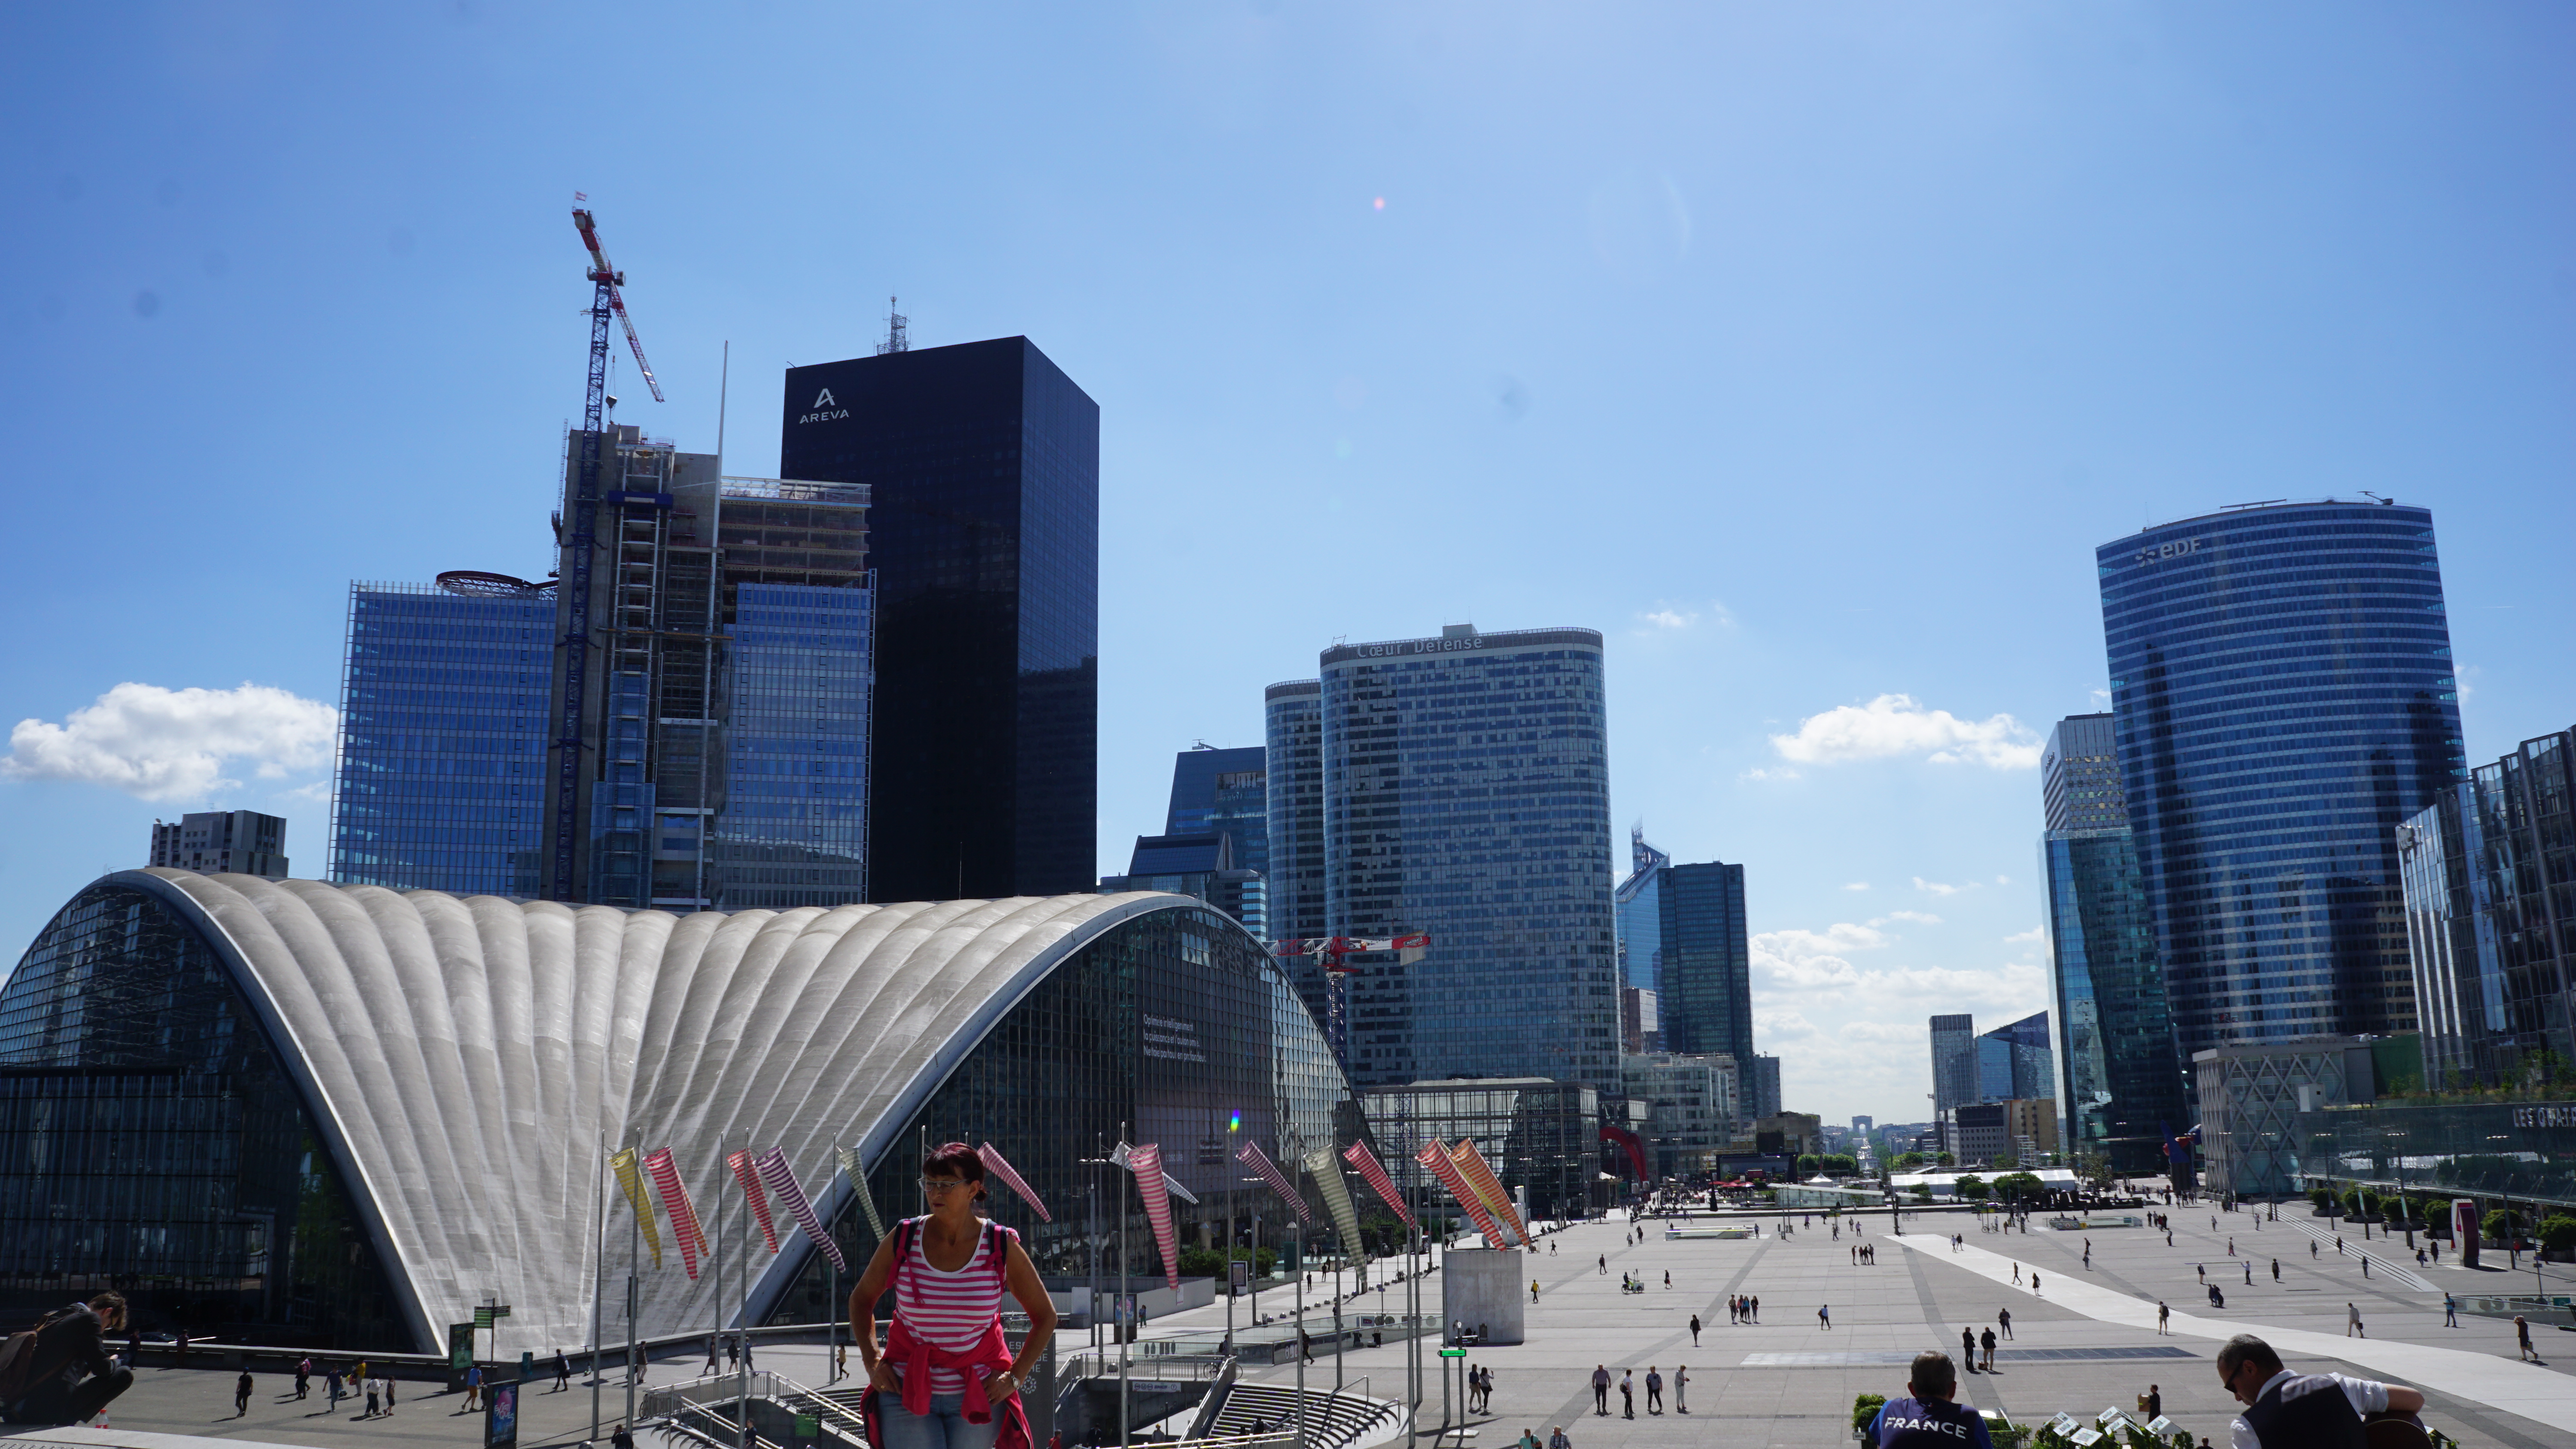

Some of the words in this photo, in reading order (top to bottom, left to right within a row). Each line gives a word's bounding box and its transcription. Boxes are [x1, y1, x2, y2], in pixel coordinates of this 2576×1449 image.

[799, 409, 849, 424] AREVA
[1358, 643, 1403, 658] Cœur
[1415, 635, 1483, 653] Défense
[1144, 1029, 1148, 1040] la
[2512, 1108, 2534, 1128] LES
[1884, 1416, 1968, 1440] FRANCE
